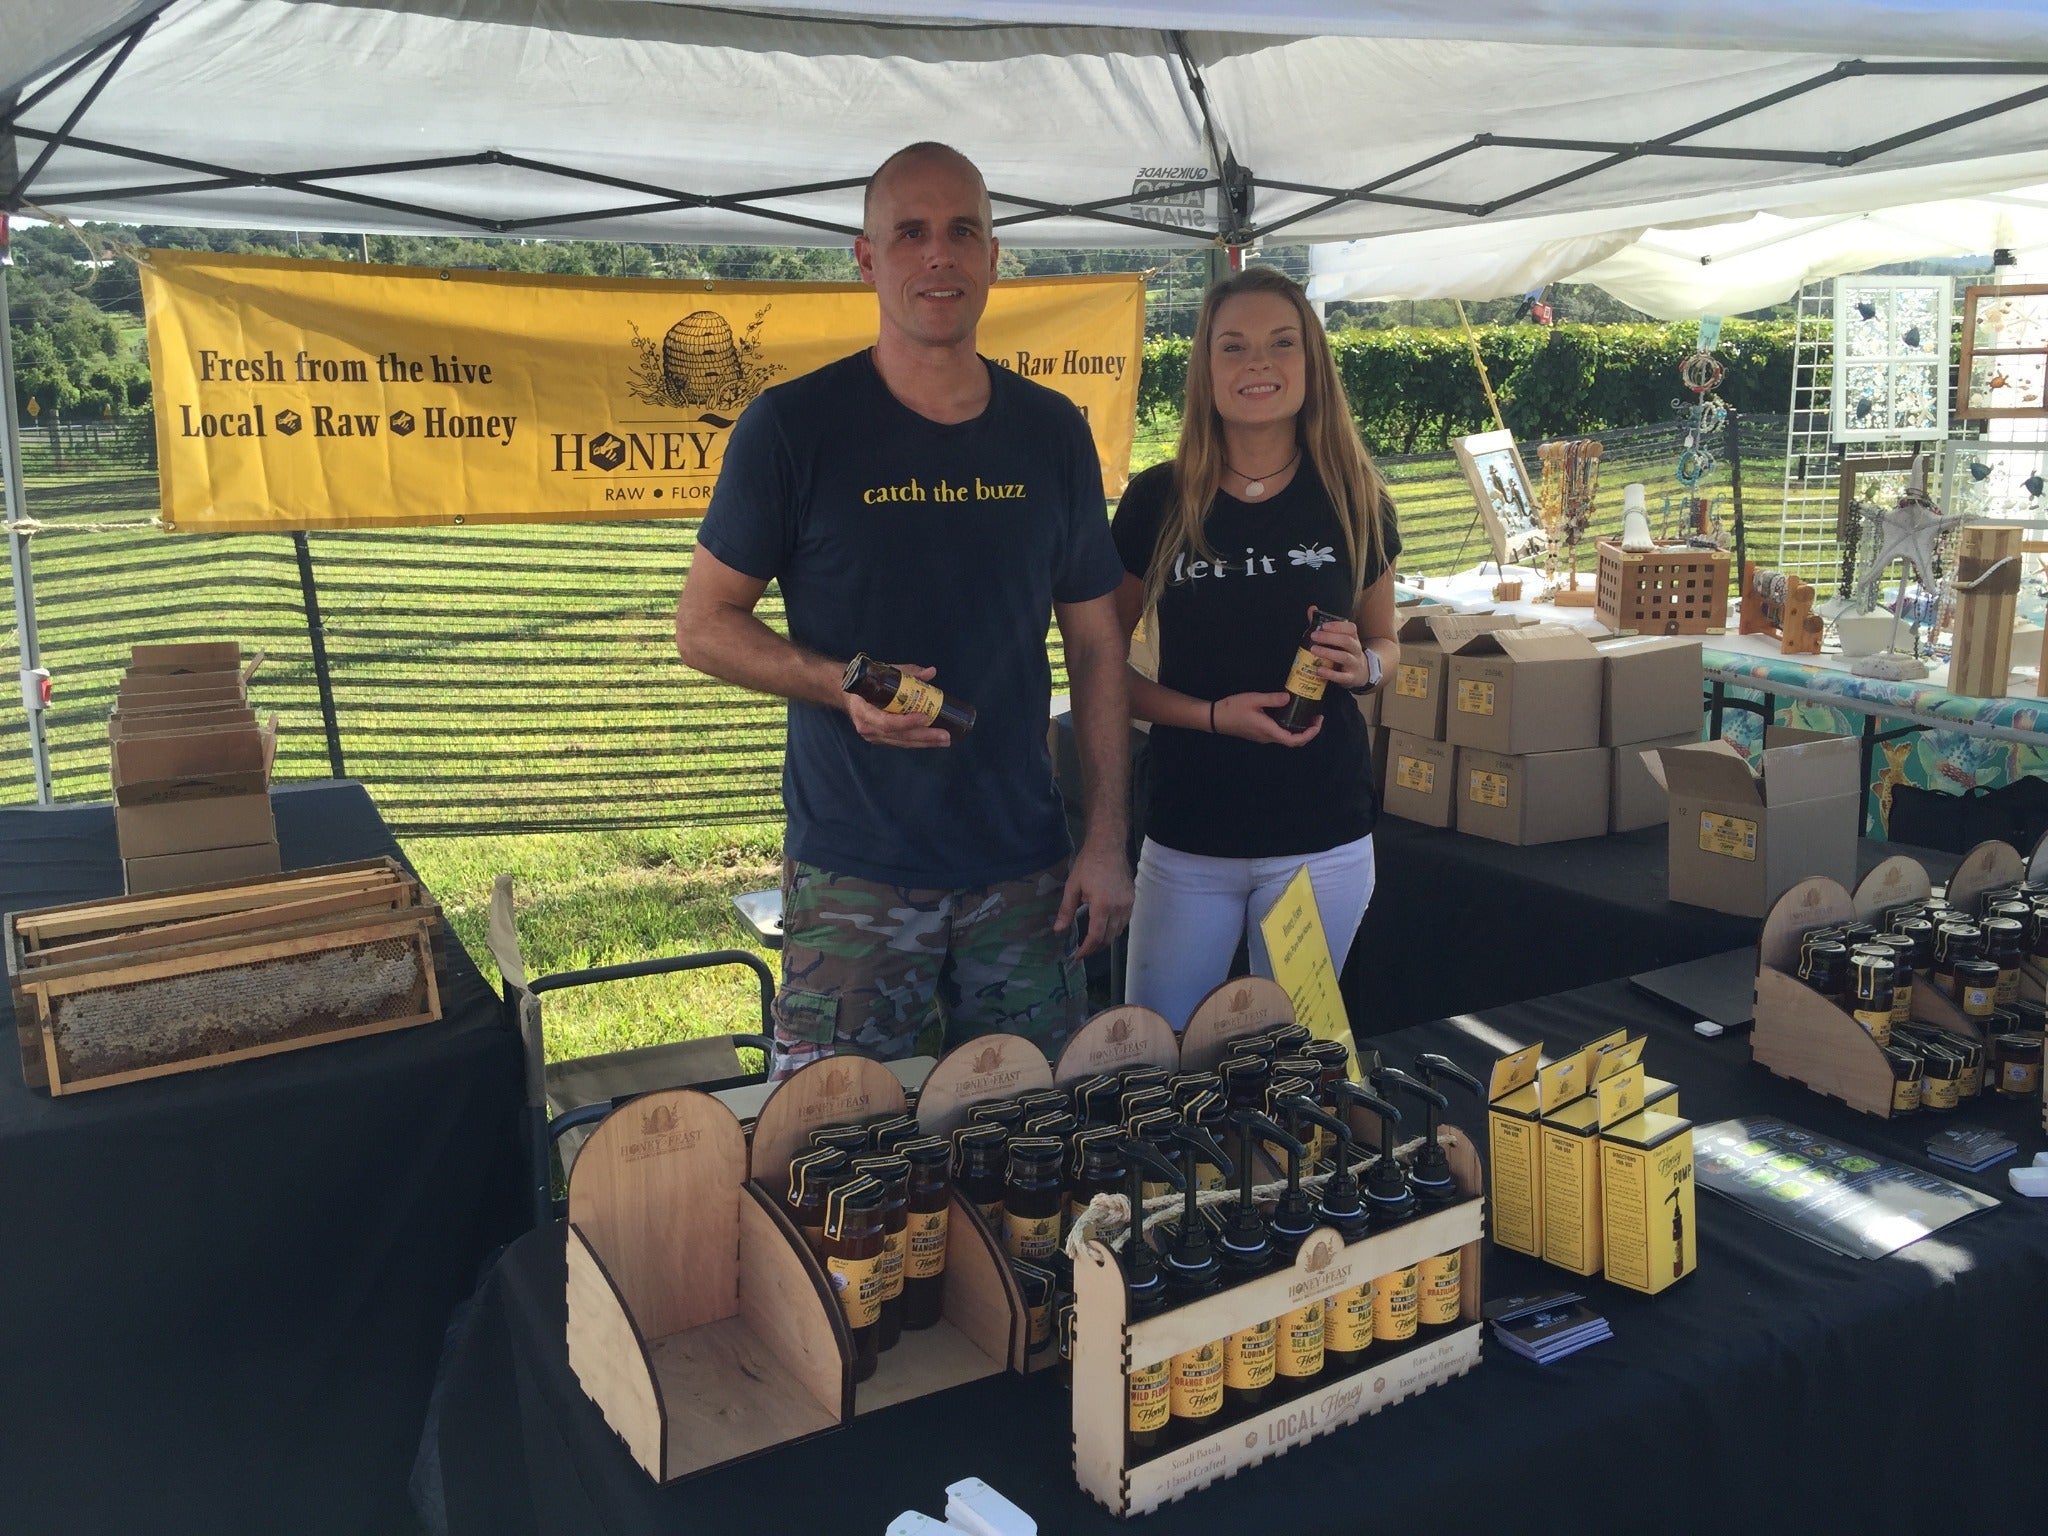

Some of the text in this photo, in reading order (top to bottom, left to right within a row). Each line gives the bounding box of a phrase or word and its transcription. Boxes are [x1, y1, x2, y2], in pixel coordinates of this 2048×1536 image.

[198, 349, 493, 385] Fresh from the hive
[1016, 351, 1058, 377] Raw
[1061, 350, 1127, 381] Honey
[180, 404, 518, 446] Local Raw Honey
[605, 487, 645, 501] RAW
[863, 477, 1027, 505] catch the buzz
[1174, 547, 1278, 582] let it
[1674, 1163, 1692, 1186] PUMP
[1288, 1277, 1321, 1298] HONEY
[1325, 1264, 1353, 1284] FEAST
[1291, 1338, 1306, 1348] SEA
[1240, 1350, 1266, 1359] FLORIDA
[1295, 1351, 1322, 1368] Honey
[1247, 1361, 1273, 1380] Honey
[1174, 1376, 1204, 1387] ORANGE
[1130, 1391, 1149, 1401] WILD
[1188, 1389, 1219, 1409] Honey
[1137, 1403, 1167, 1422] Honey
[1268, 1381, 1364, 1446] LOCAL Honey
[1171, 1451, 1196, 1471] Small
[1193, 1454, 1226, 1478] Crafted
